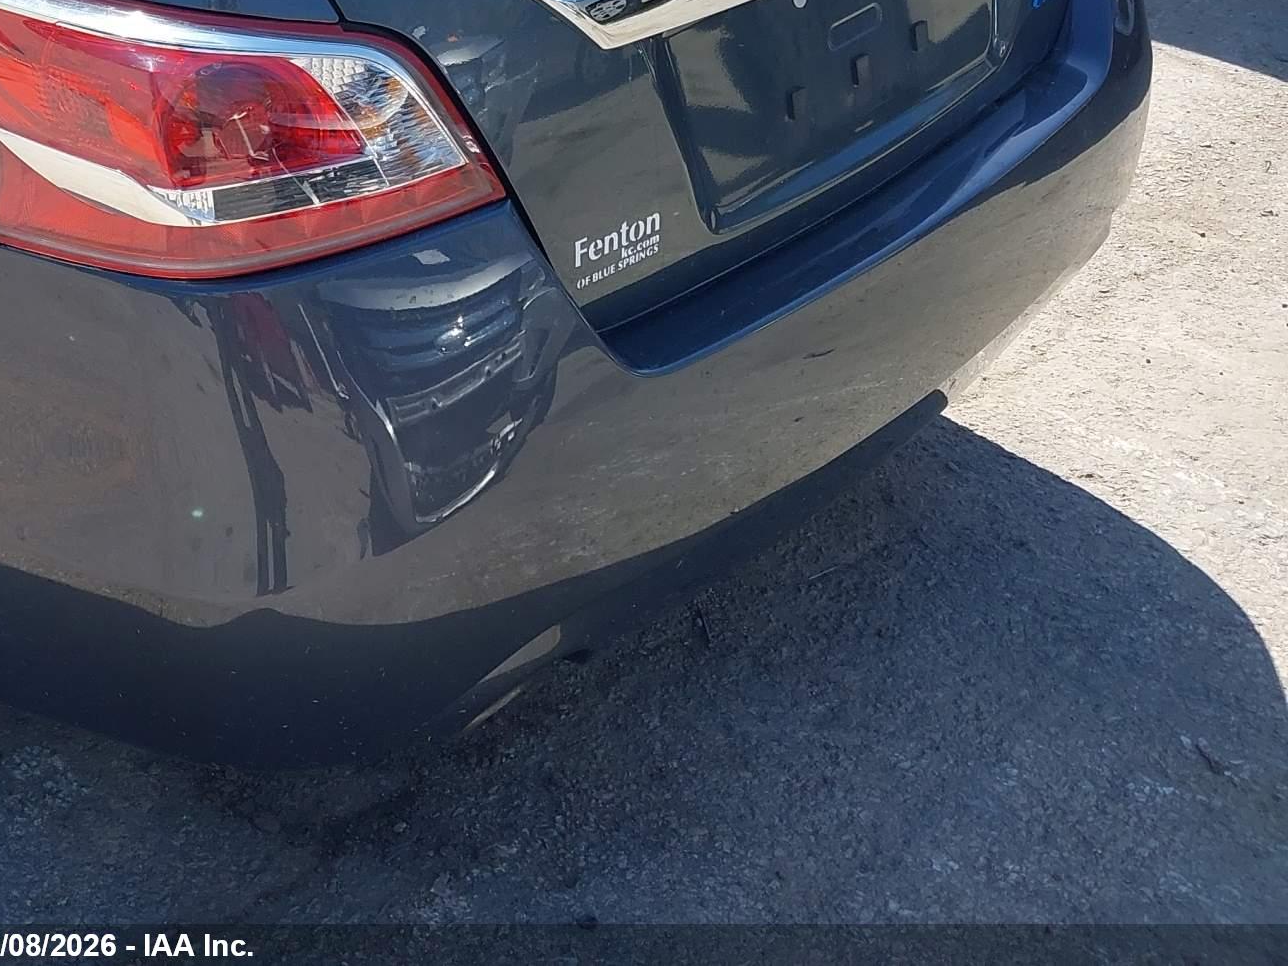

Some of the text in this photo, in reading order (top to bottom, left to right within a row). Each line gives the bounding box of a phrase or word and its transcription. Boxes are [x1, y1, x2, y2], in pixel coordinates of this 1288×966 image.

[574, 212, 661, 269] Fenton
[621, 234, 660, 259] kc.com
[576, 244, 660, 290] OF BLUE SPRINGS
